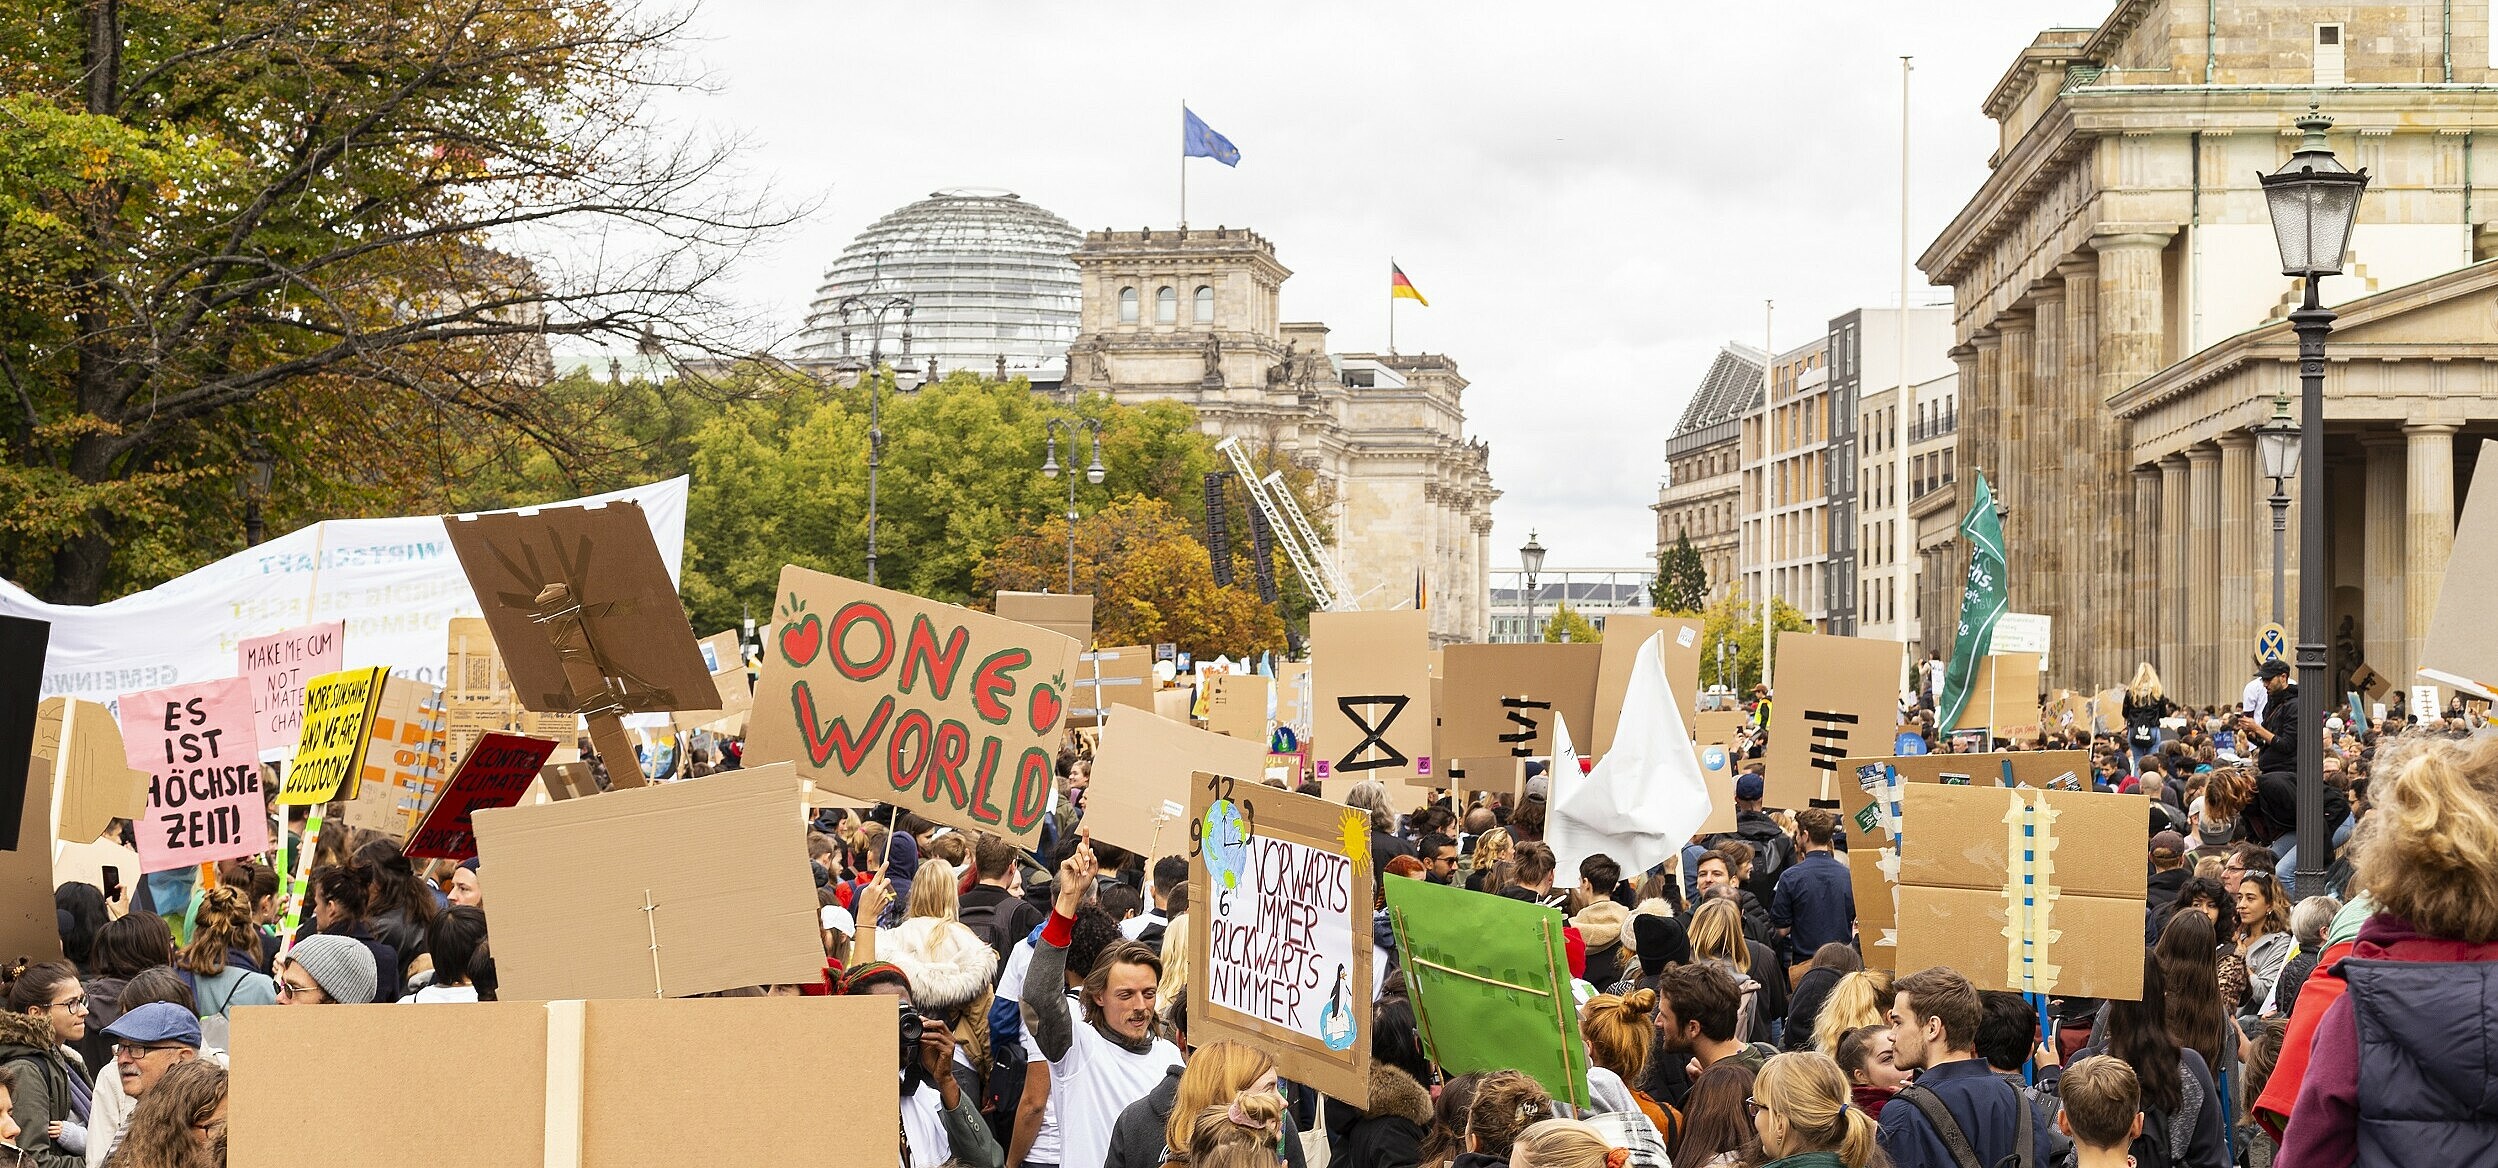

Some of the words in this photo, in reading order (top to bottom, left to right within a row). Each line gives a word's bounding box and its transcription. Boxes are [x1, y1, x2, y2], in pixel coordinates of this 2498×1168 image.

[247, 642, 281, 671] MAKE
[285, 637, 302, 662] ME
[307, 633, 332, 657] CUM
[828, 600, 1032, 725] ONE
[267, 668, 300, 692] NOT
[306, 684, 332, 716] MORE
[330, 679, 369, 709] SUNSHINE
[164, 697, 207, 731] ES
[254, 686, 305, 714] LIMATE
[164, 728, 222, 764] IST
[298, 719, 322, 756] AND
[322, 715, 341, 749] WE
[336, 712, 361, 746] ARE
[791, 680, 1053, 836] WORLD
[456, 772, 531, 793] CLIMATE
[1208, 774, 1235, 801] 12
[161, 804, 241, 849] ZEIT!
[1190, 817, 1203, 857] 9
[1250, 836, 1350, 914] VORWÄRTS
[1219, 890, 1230, 917] 6
[1256, 893, 1318, 950] IMMER
[1211, 963, 1303, 1029] NIMMER
